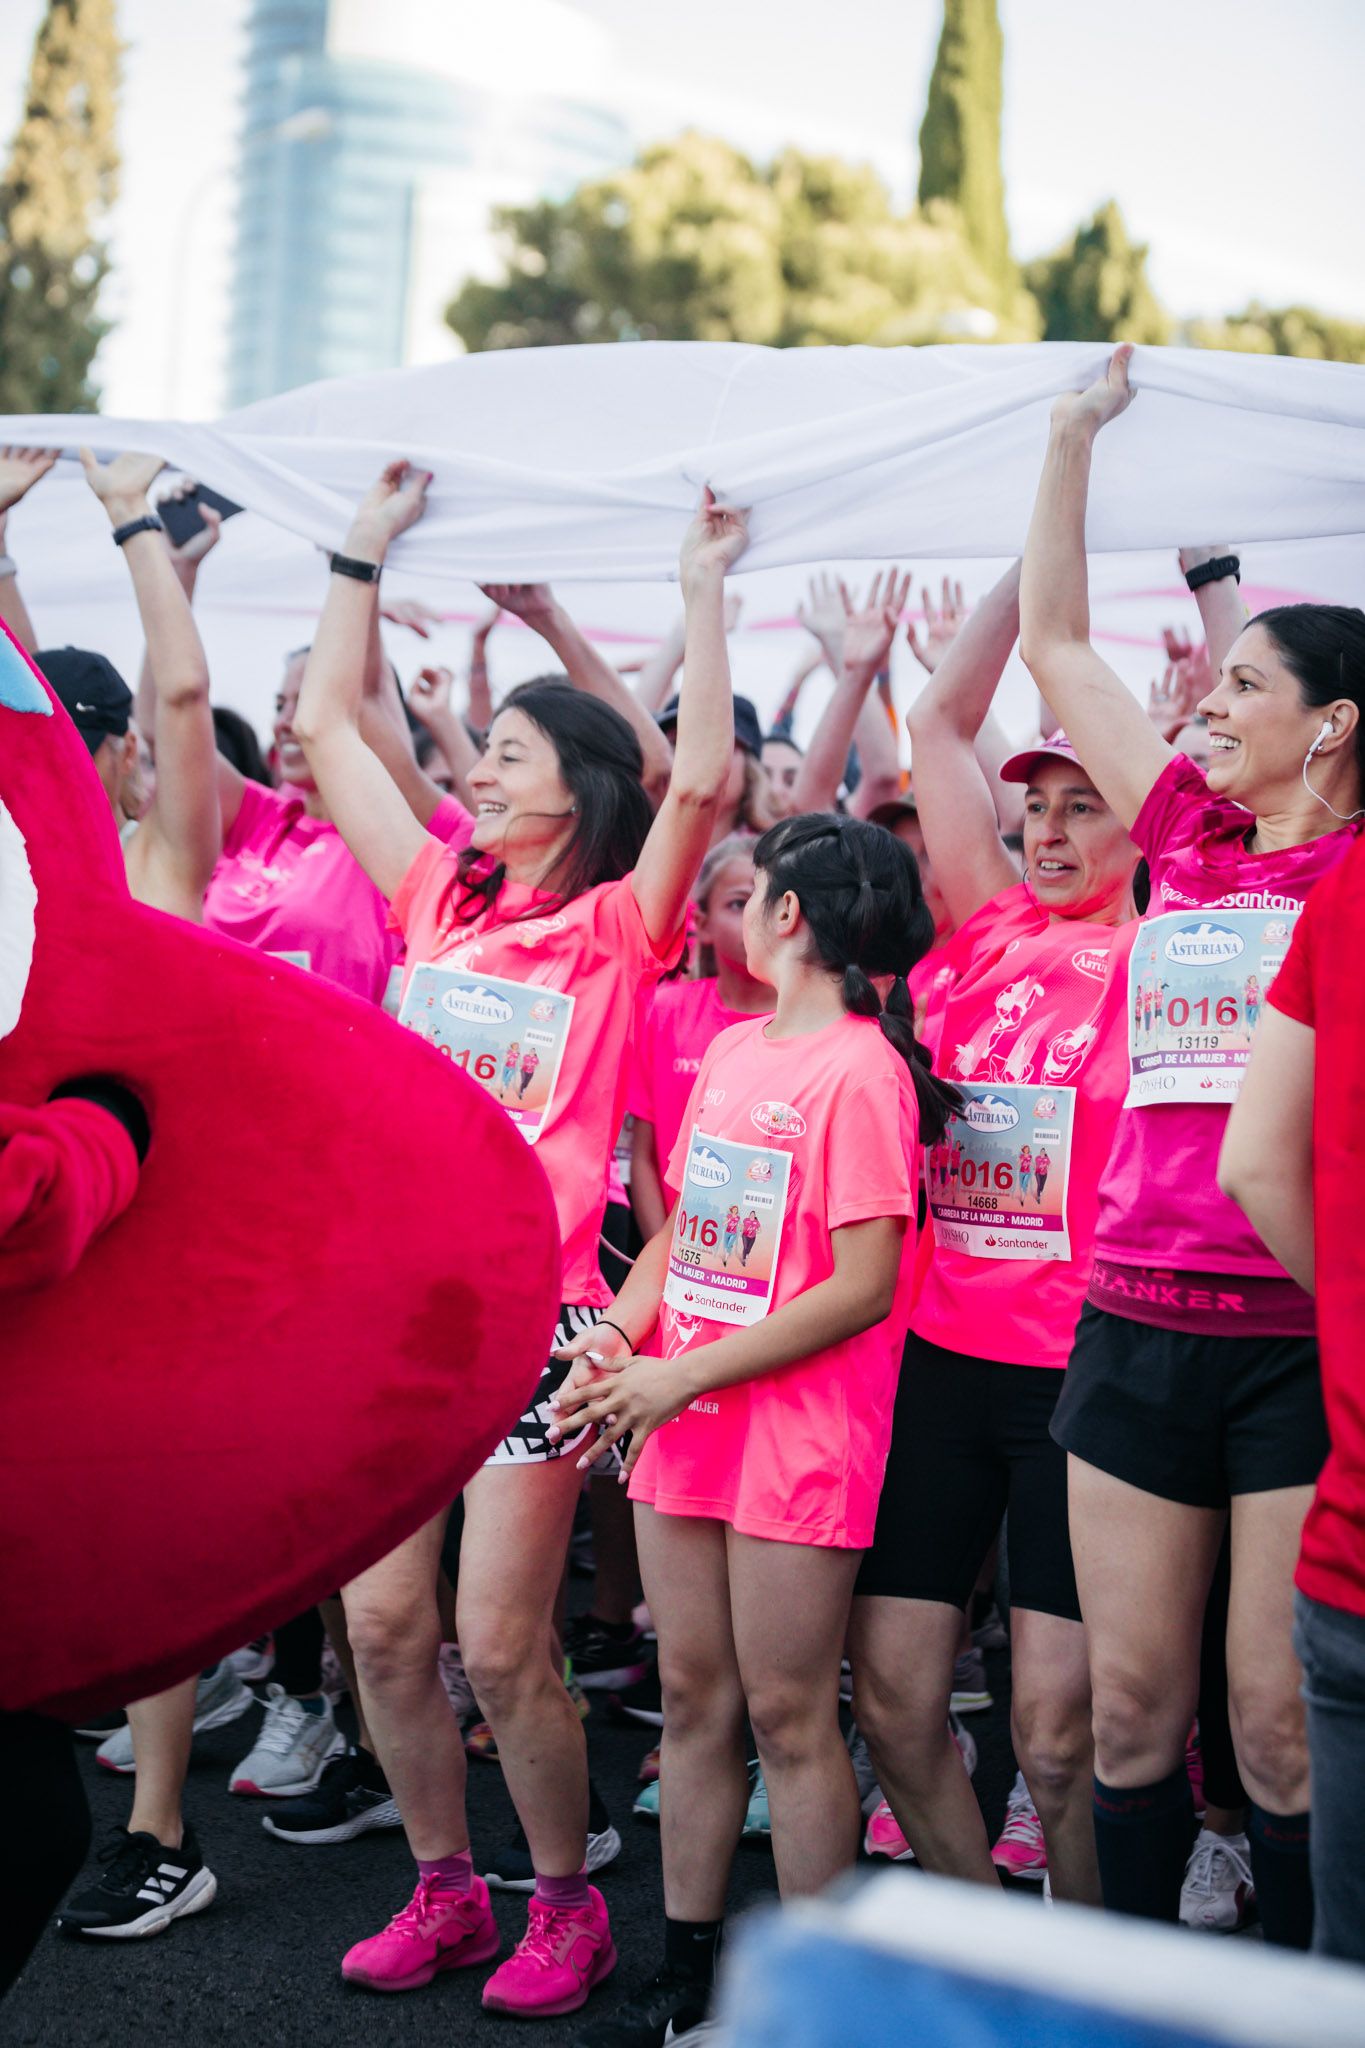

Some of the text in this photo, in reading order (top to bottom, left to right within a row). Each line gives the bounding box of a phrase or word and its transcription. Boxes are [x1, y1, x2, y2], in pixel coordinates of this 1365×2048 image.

[1074, 954, 1108, 975] ASTU
[1167, 996, 1238, 1028] 016
[1177, 1035, 1219, 1049] 13119
[1164, 1053, 1179, 1064] DE
[1179, 1053, 1192, 1064] LA
[1193, 1053, 1226, 1064] MUJER
[960, 1159, 1014, 1191] 016
[967, 1195, 998, 1210] 14668
[961, 1211, 970, 1221] DE
[970, 1212, 979, 1222] LA
[980, 1213, 1005, 1224] MUJER
[1011, 1216, 1044, 1228] MADRID
[679, 1210, 719, 1247] 016
[997, 1237, 1049, 1250] Santander
[711, 1274, 748, 1290] MADRID
[695, 1293, 748, 1314] Santander
